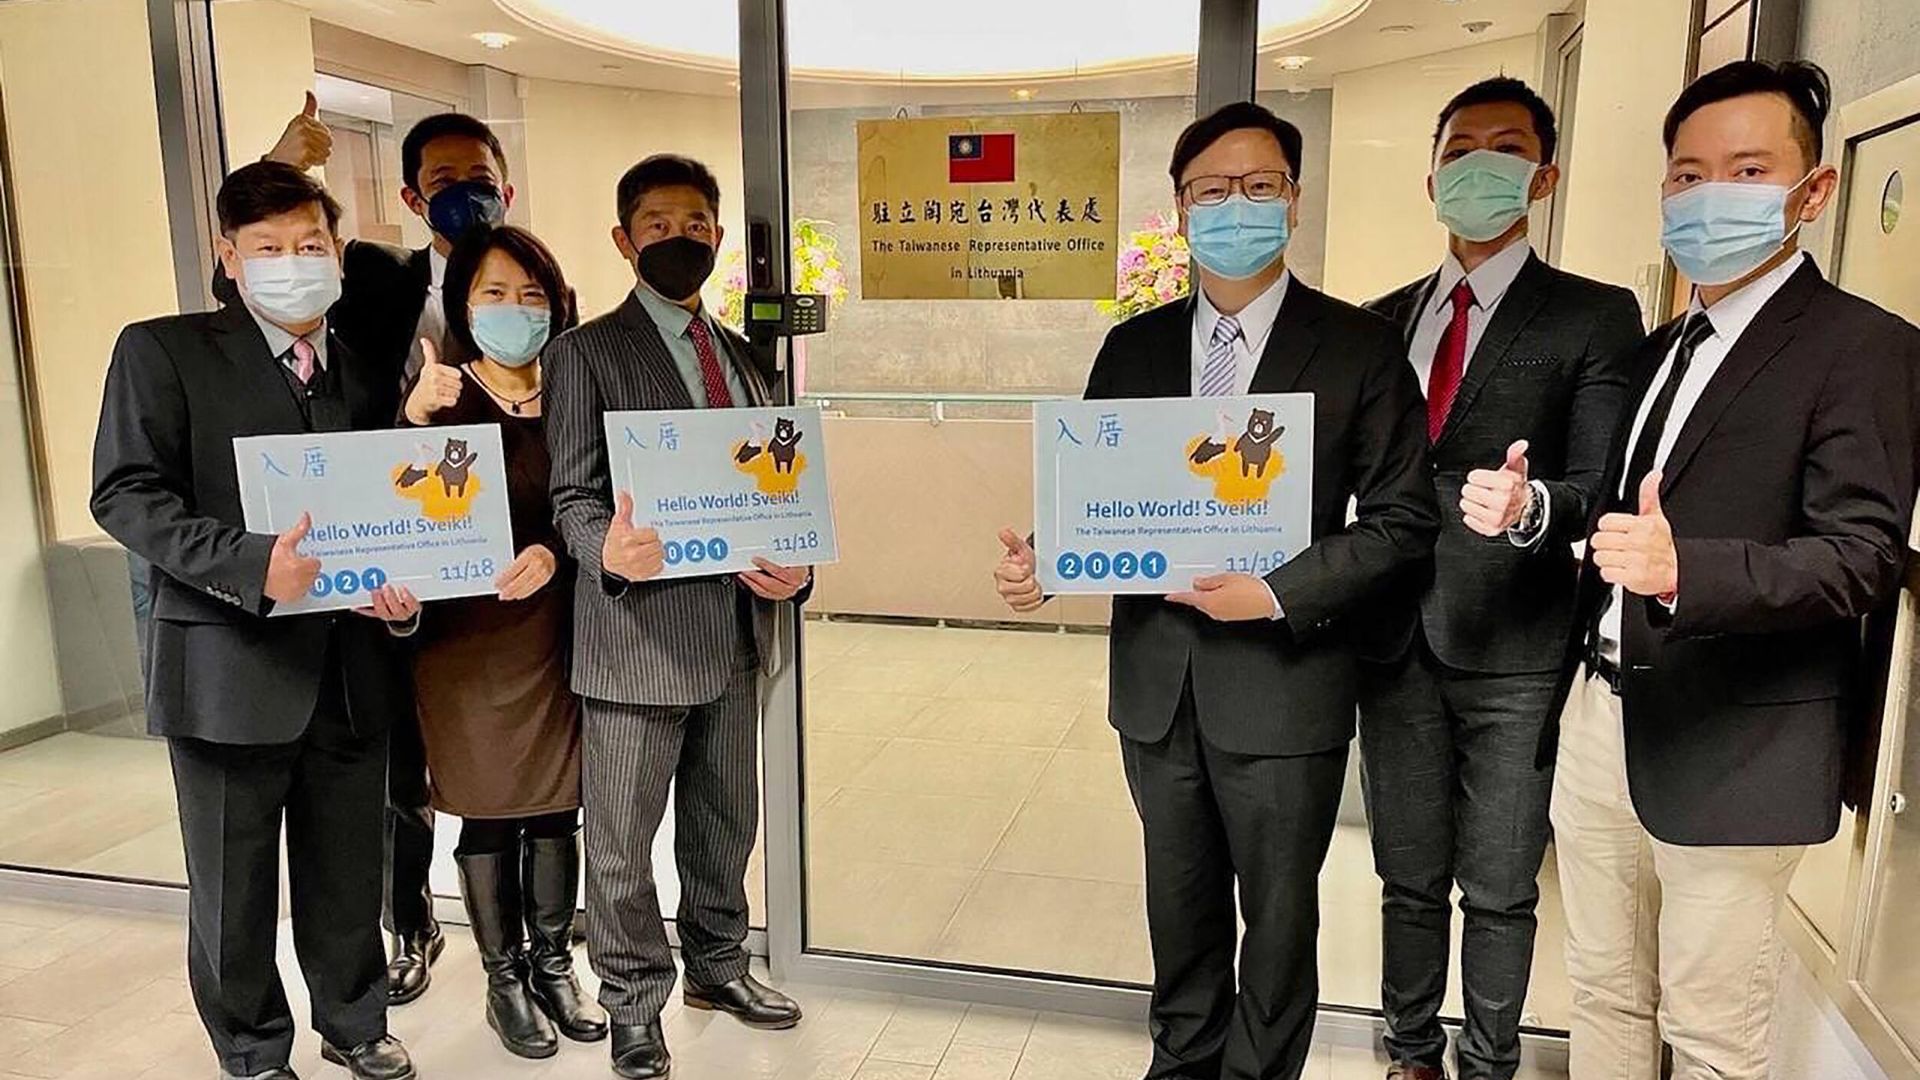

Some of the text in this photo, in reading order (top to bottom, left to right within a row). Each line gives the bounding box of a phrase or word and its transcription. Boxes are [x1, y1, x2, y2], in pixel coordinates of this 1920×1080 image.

[872, 196, 1103, 224] 駐立陶宛台灣代表處
[872, 237, 1105, 253] The Taiwanese Representative Office
[950, 265, 1025, 279] in Lithuania
[624, 420, 680, 451] 入厝
[1056, 412, 1124, 448] 入厝
[260, 445, 328, 479] 入厝
[656, 489, 800, 513] Hello World! Sveiki!
[1085, 498, 1269, 518] Hello World! Sveiki!
[352, 519, 412, 538] World!
[415, 514, 473, 533] Sveiki!
[1075, 527, 1091, 535] The
[1092, 527, 1136, 535] Taiwanese
[1137, 525, 1202, 537] Representative
[1203, 524, 1229, 534] Office
[667, 530, 819, 561] 021 11/18
[312, 557, 495, 593] 021 11/18
[1063, 555, 1160, 576] 2021
